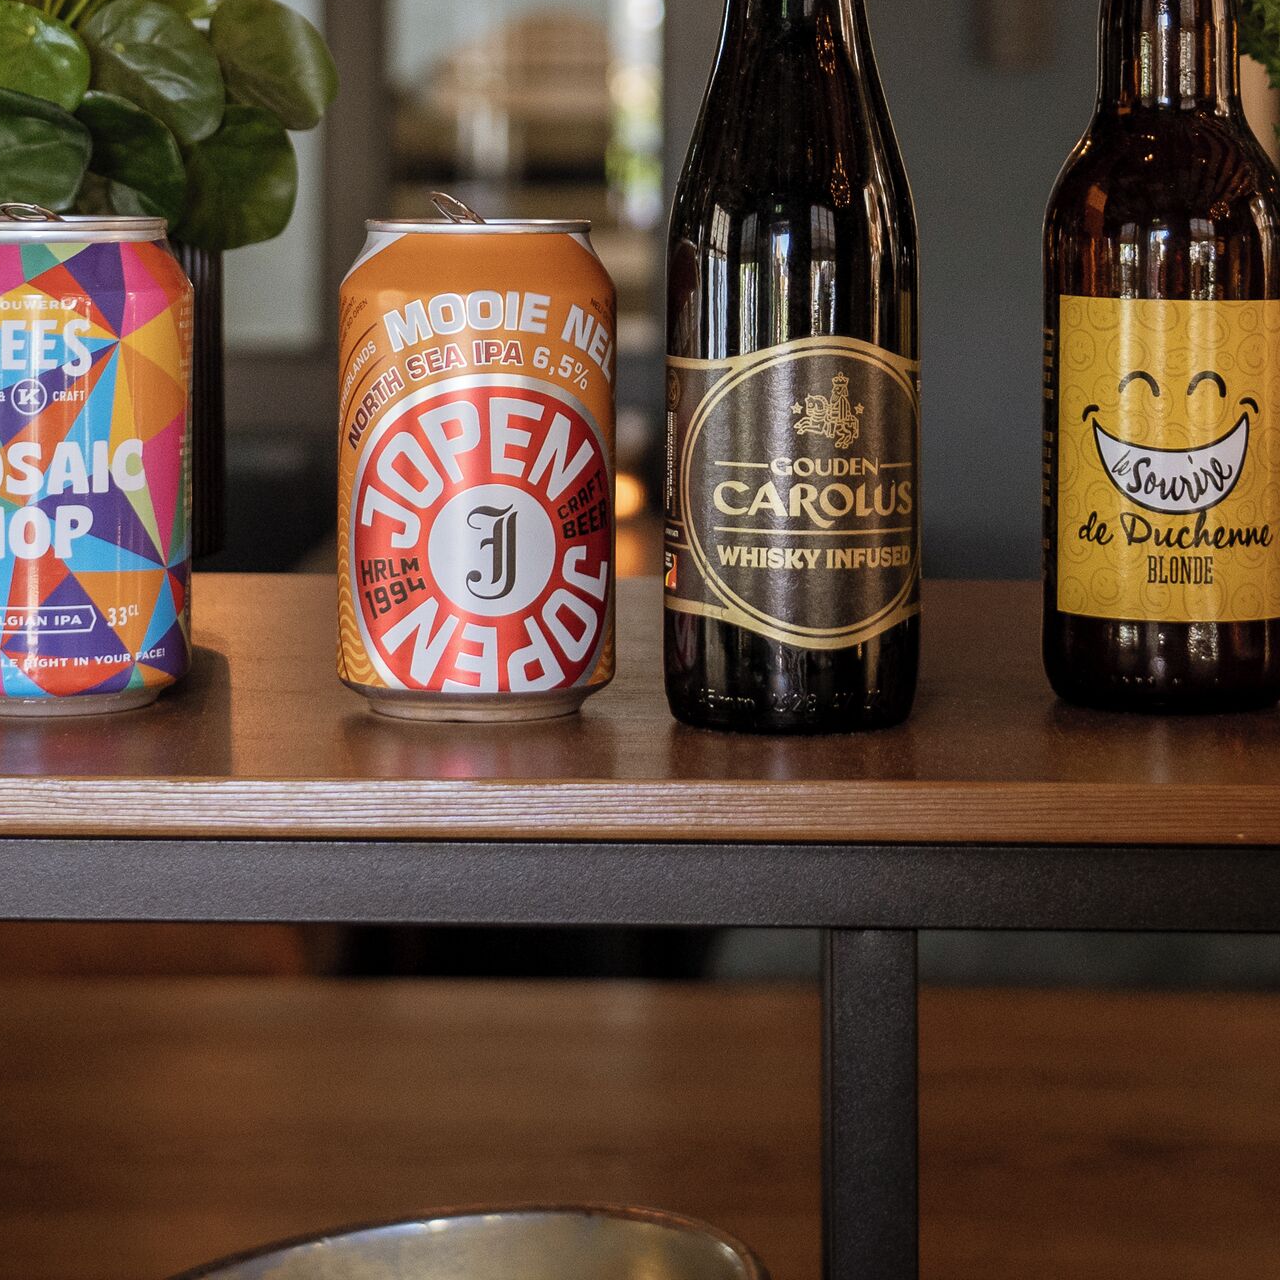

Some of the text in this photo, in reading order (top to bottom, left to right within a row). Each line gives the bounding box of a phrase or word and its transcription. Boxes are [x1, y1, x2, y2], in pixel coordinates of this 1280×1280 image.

[384, 289, 552, 353] MOOIE
[52, 390, 85, 402] CRAFT
[348, 338, 590, 451] NORTH SEA IPA 6,5%
[361, 396, 595, 549] JOPEN
[770, 456, 879, 477] GOUDEN
[1126, 454, 1233, 504] Sourire
[557, 469, 604, 521] CRAFT
[713, 479, 913, 529] CAROLUS
[562, 497, 608, 540] BEER
[1078, 509, 1274, 550] de Duchenne
[360, 556, 420, 587] HRLM
[717, 544, 911, 570] WHISKY INFUSED
[1147, 555, 1214, 585] BLONDE
[364, 576, 427, 621] 1994
[54, 614, 83, 626] IPA
[23, 656, 69, 669] RIGHT
[73, 656, 89, 667] IN
[94, 653, 131, 665] YOUR
[135, 647, 166, 661] FACE!
